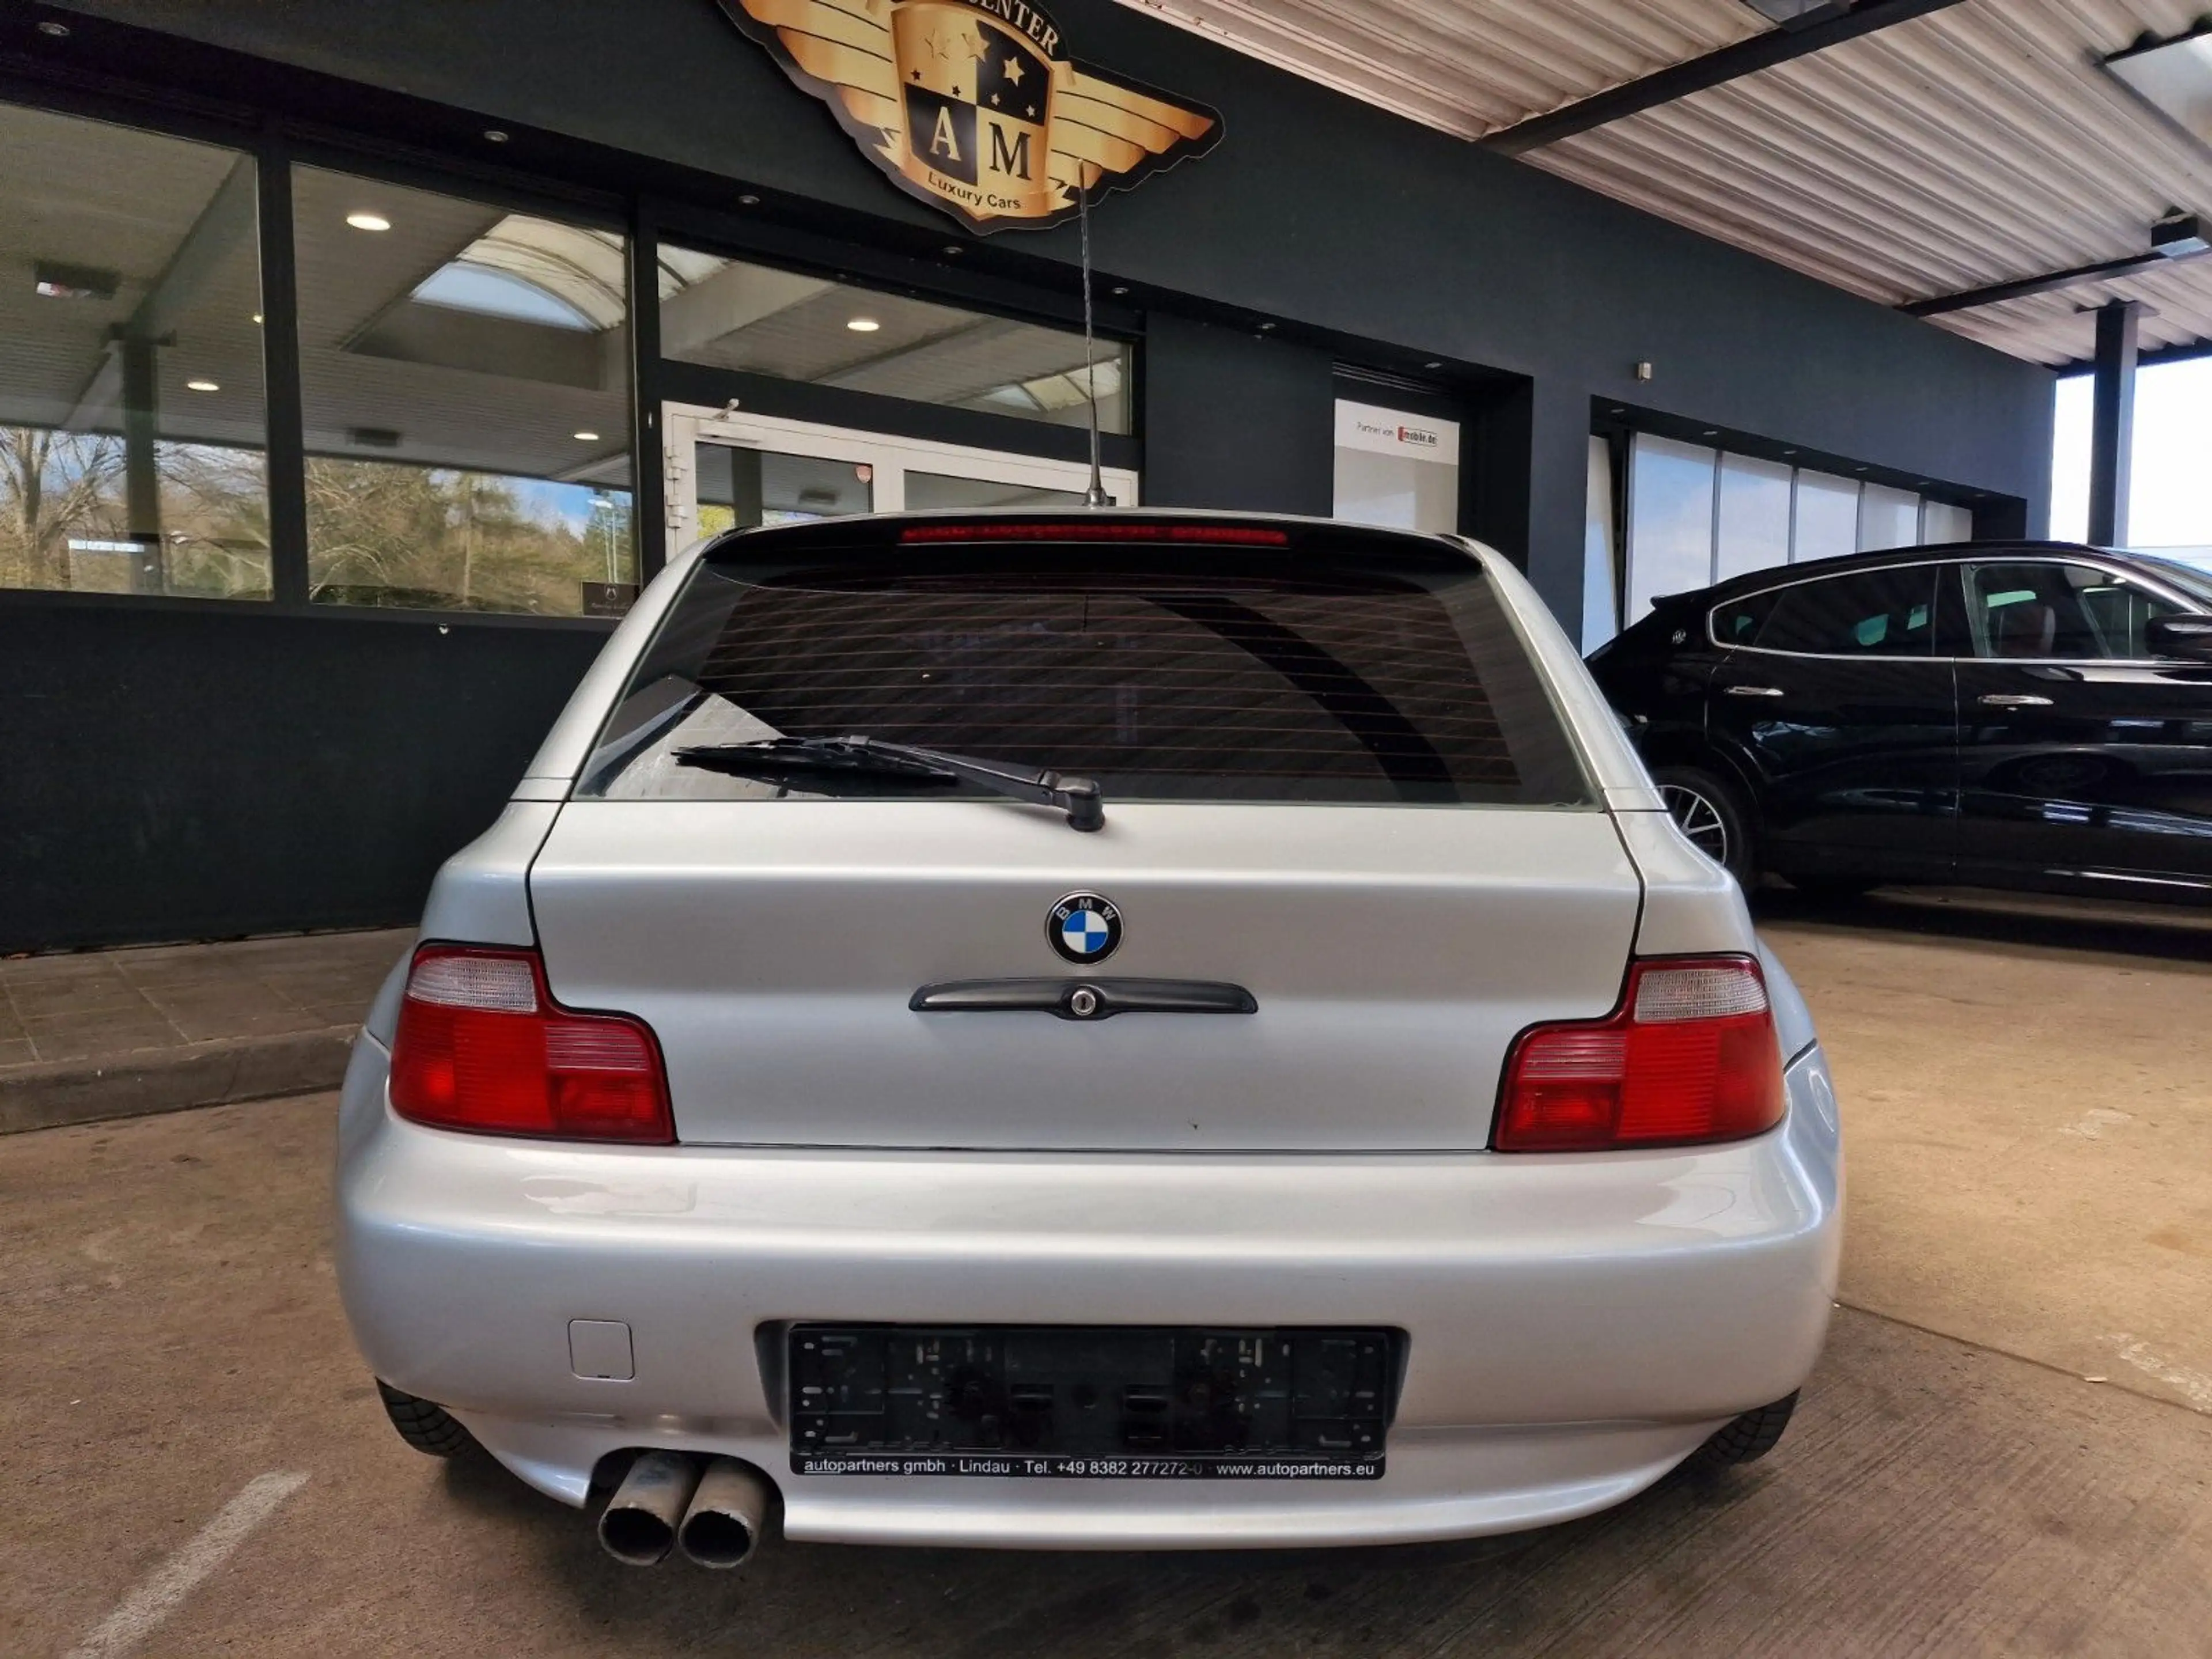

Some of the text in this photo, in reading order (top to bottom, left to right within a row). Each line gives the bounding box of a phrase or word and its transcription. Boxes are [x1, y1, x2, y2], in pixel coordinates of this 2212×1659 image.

[969, 0, 1058, 56] NTER
[929, 106, 1032, 181] A M
[928, 171, 1021, 209] Luxury Cars
[1055, 898, 1116, 921] BMW
[804, 1459, 1374, 1478] autopartners gmbh Lindau Tel. +49 8382 277272-0 www.autopartners.eu
